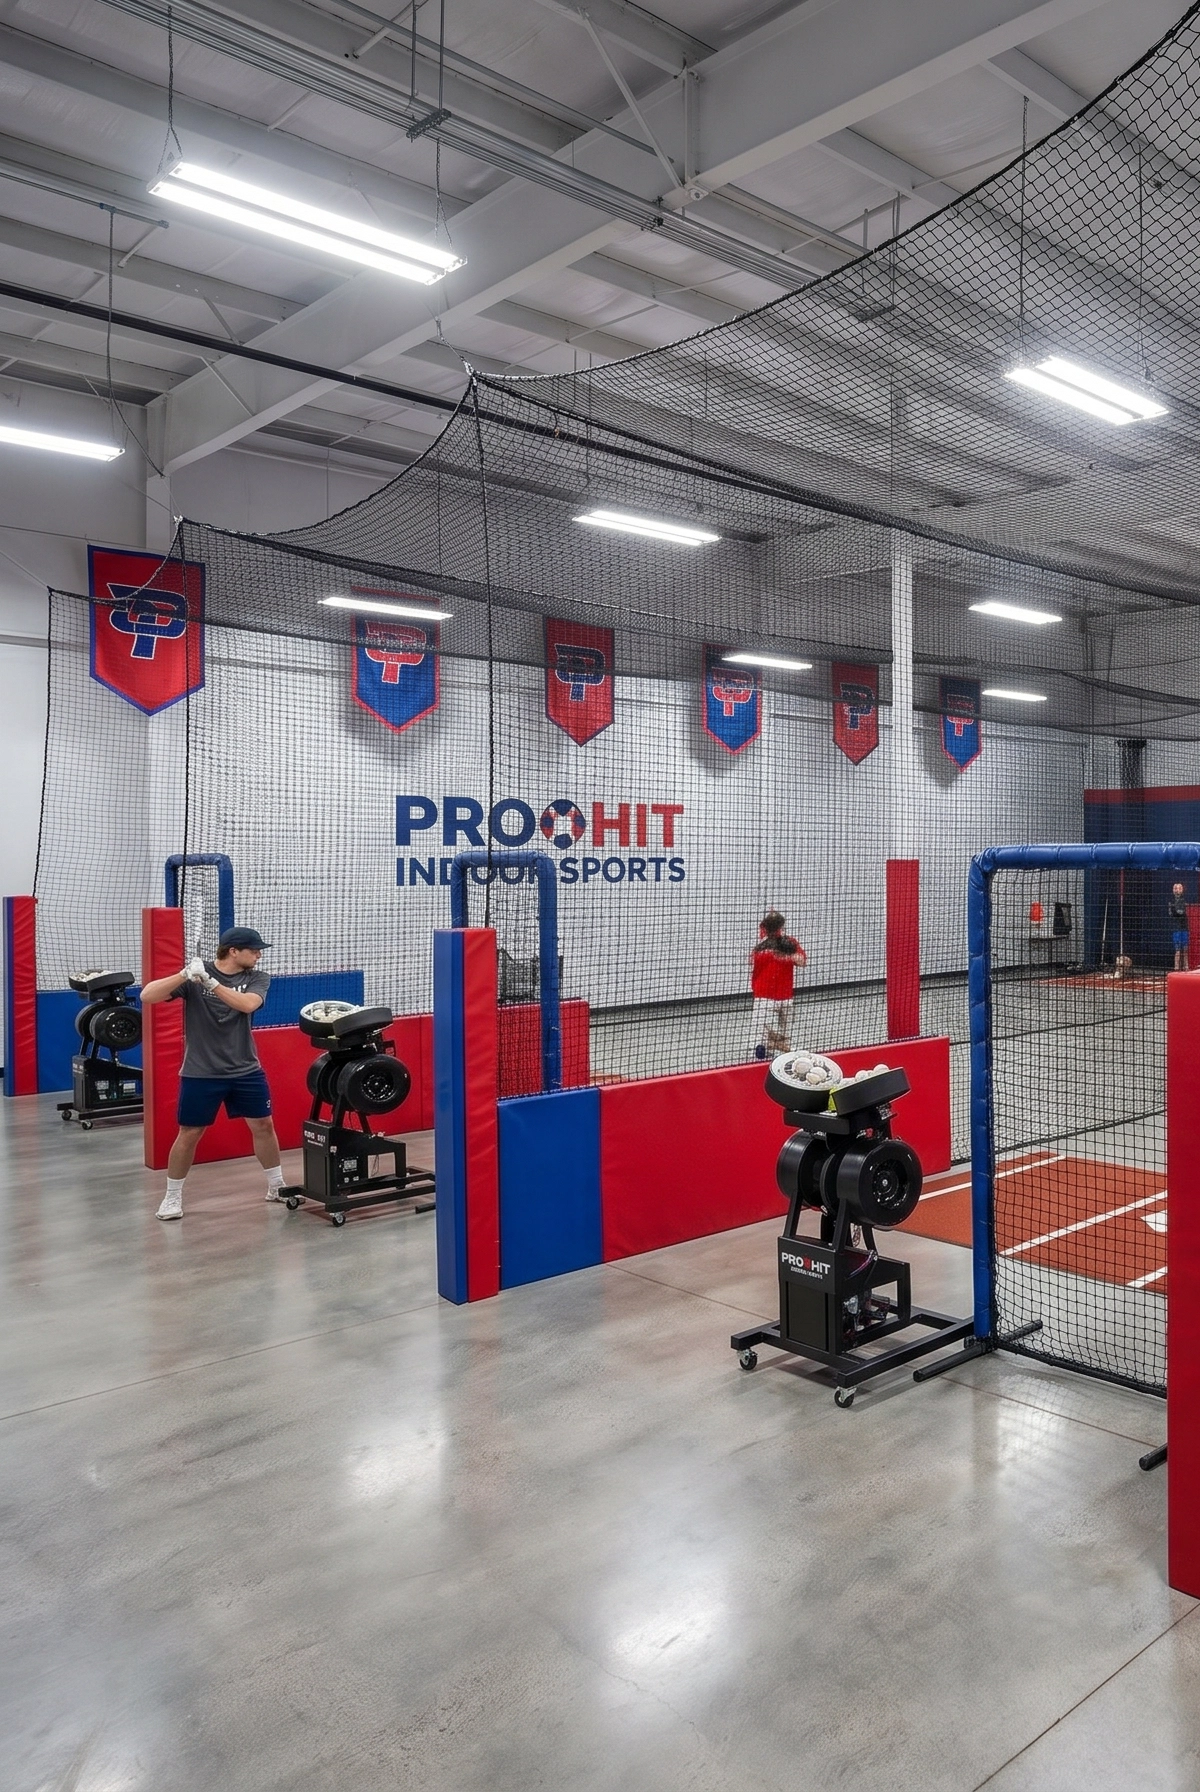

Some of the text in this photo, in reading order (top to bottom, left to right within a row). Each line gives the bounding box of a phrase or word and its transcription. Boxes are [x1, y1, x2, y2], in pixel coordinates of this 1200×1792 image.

[395, 795, 684, 848] PRO HIT
[560, 856, 685, 884] SPORTS
[781, 1252, 804, 1267] PRO
[811, 1260, 831, 1275] HIT
